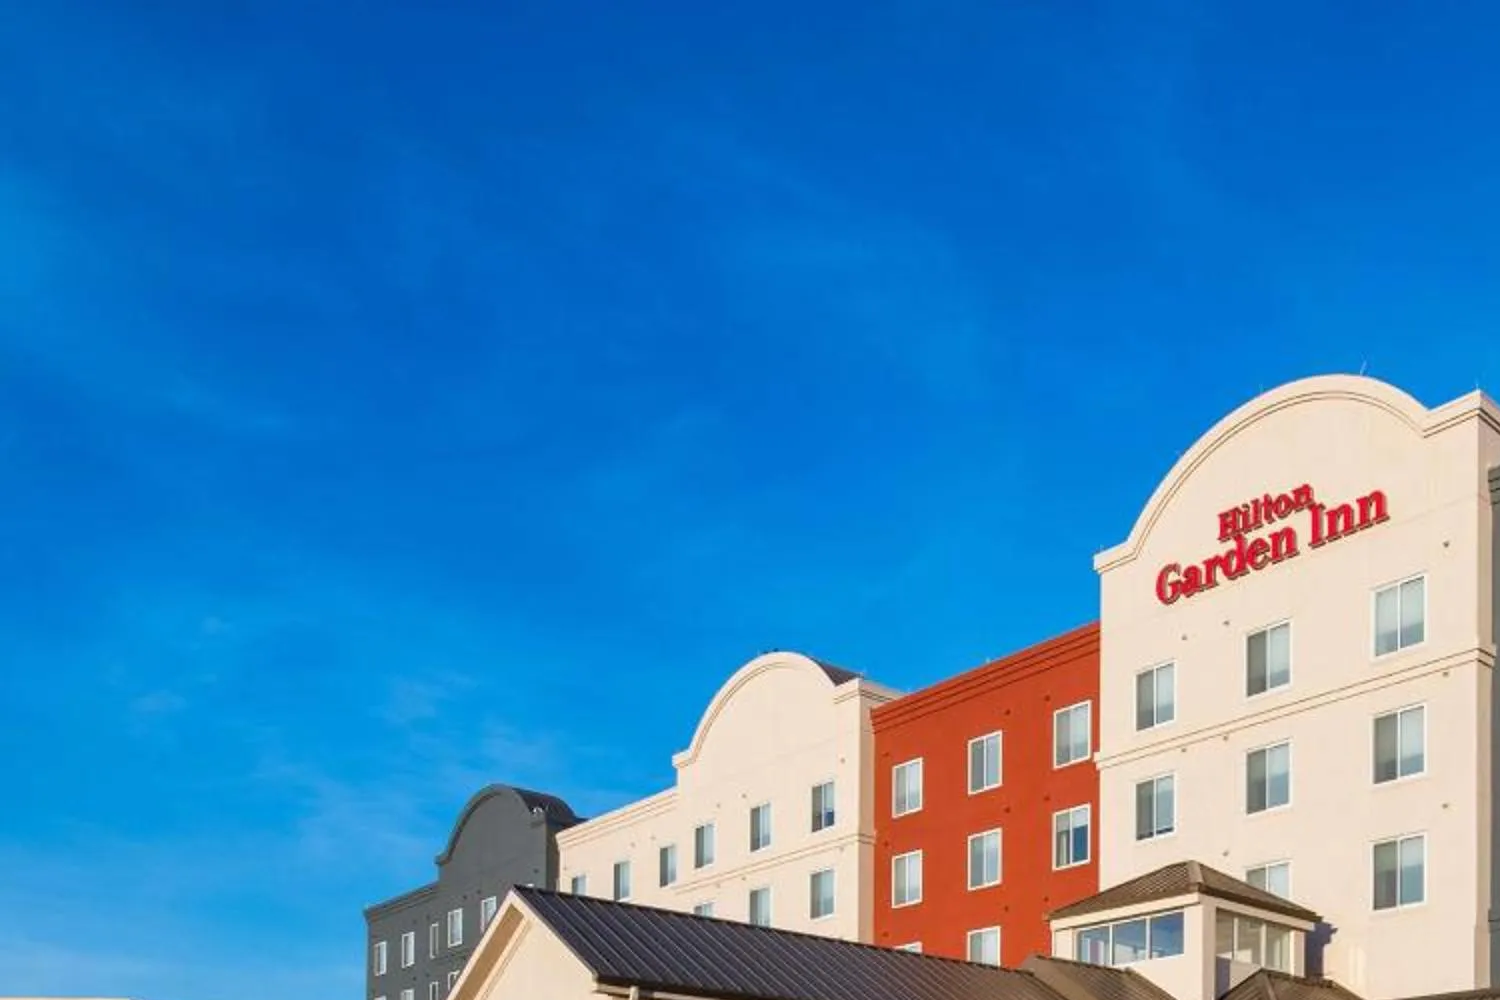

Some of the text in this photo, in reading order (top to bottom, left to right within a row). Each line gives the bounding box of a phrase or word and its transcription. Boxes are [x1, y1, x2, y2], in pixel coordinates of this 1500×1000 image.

[1155, 489, 1390, 606] Garden Inn
[1217, 483, 1315, 543] Hilton
